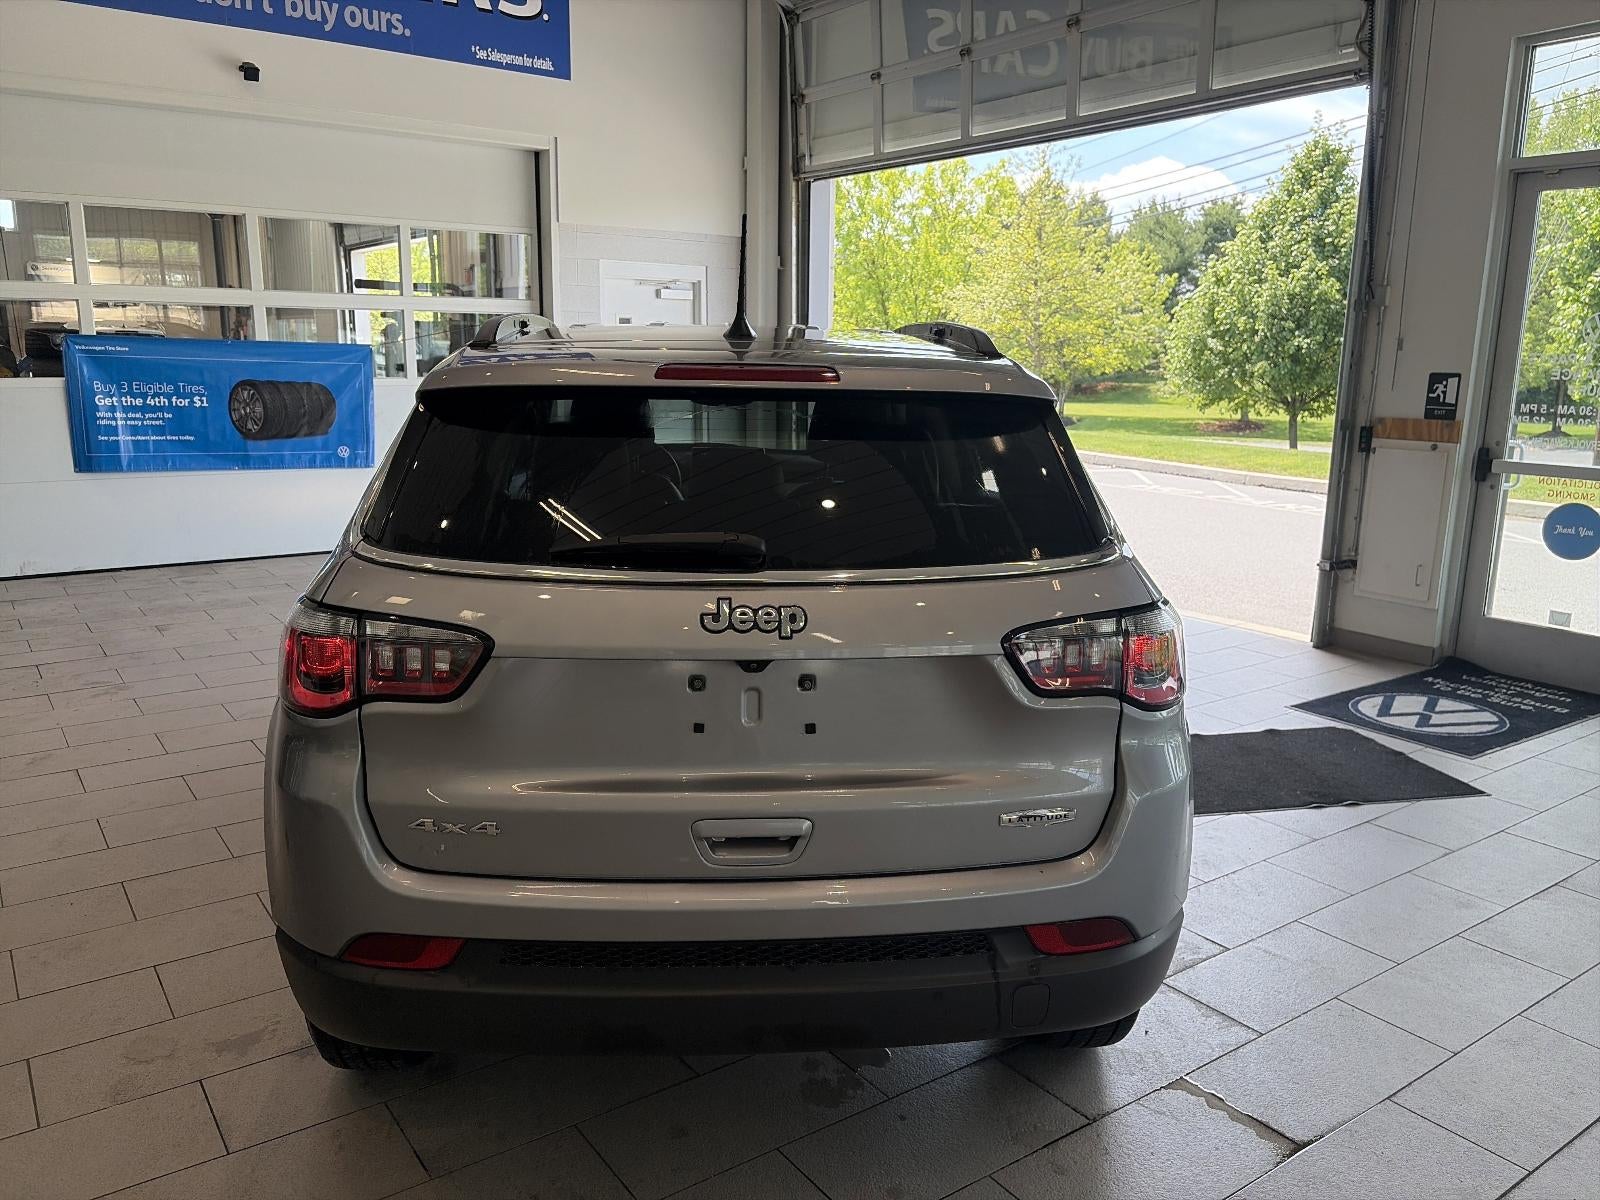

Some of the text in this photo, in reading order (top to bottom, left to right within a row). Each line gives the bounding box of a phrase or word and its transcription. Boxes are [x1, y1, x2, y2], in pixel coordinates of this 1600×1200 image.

[285, 0, 339, 31] buy
[344, 5, 411, 37] ours.
[476, 46, 554, 71] See Salesperson for details.
[93, 381, 208, 395] Buy 3 Eligible Tires,
[95, 395, 209, 408] Get the 4th for $1
[1553, 524, 1594, 537] Thank You
[700, 597, 808, 640] Jeep
[1008, 812, 1070, 823] LATITUDE
